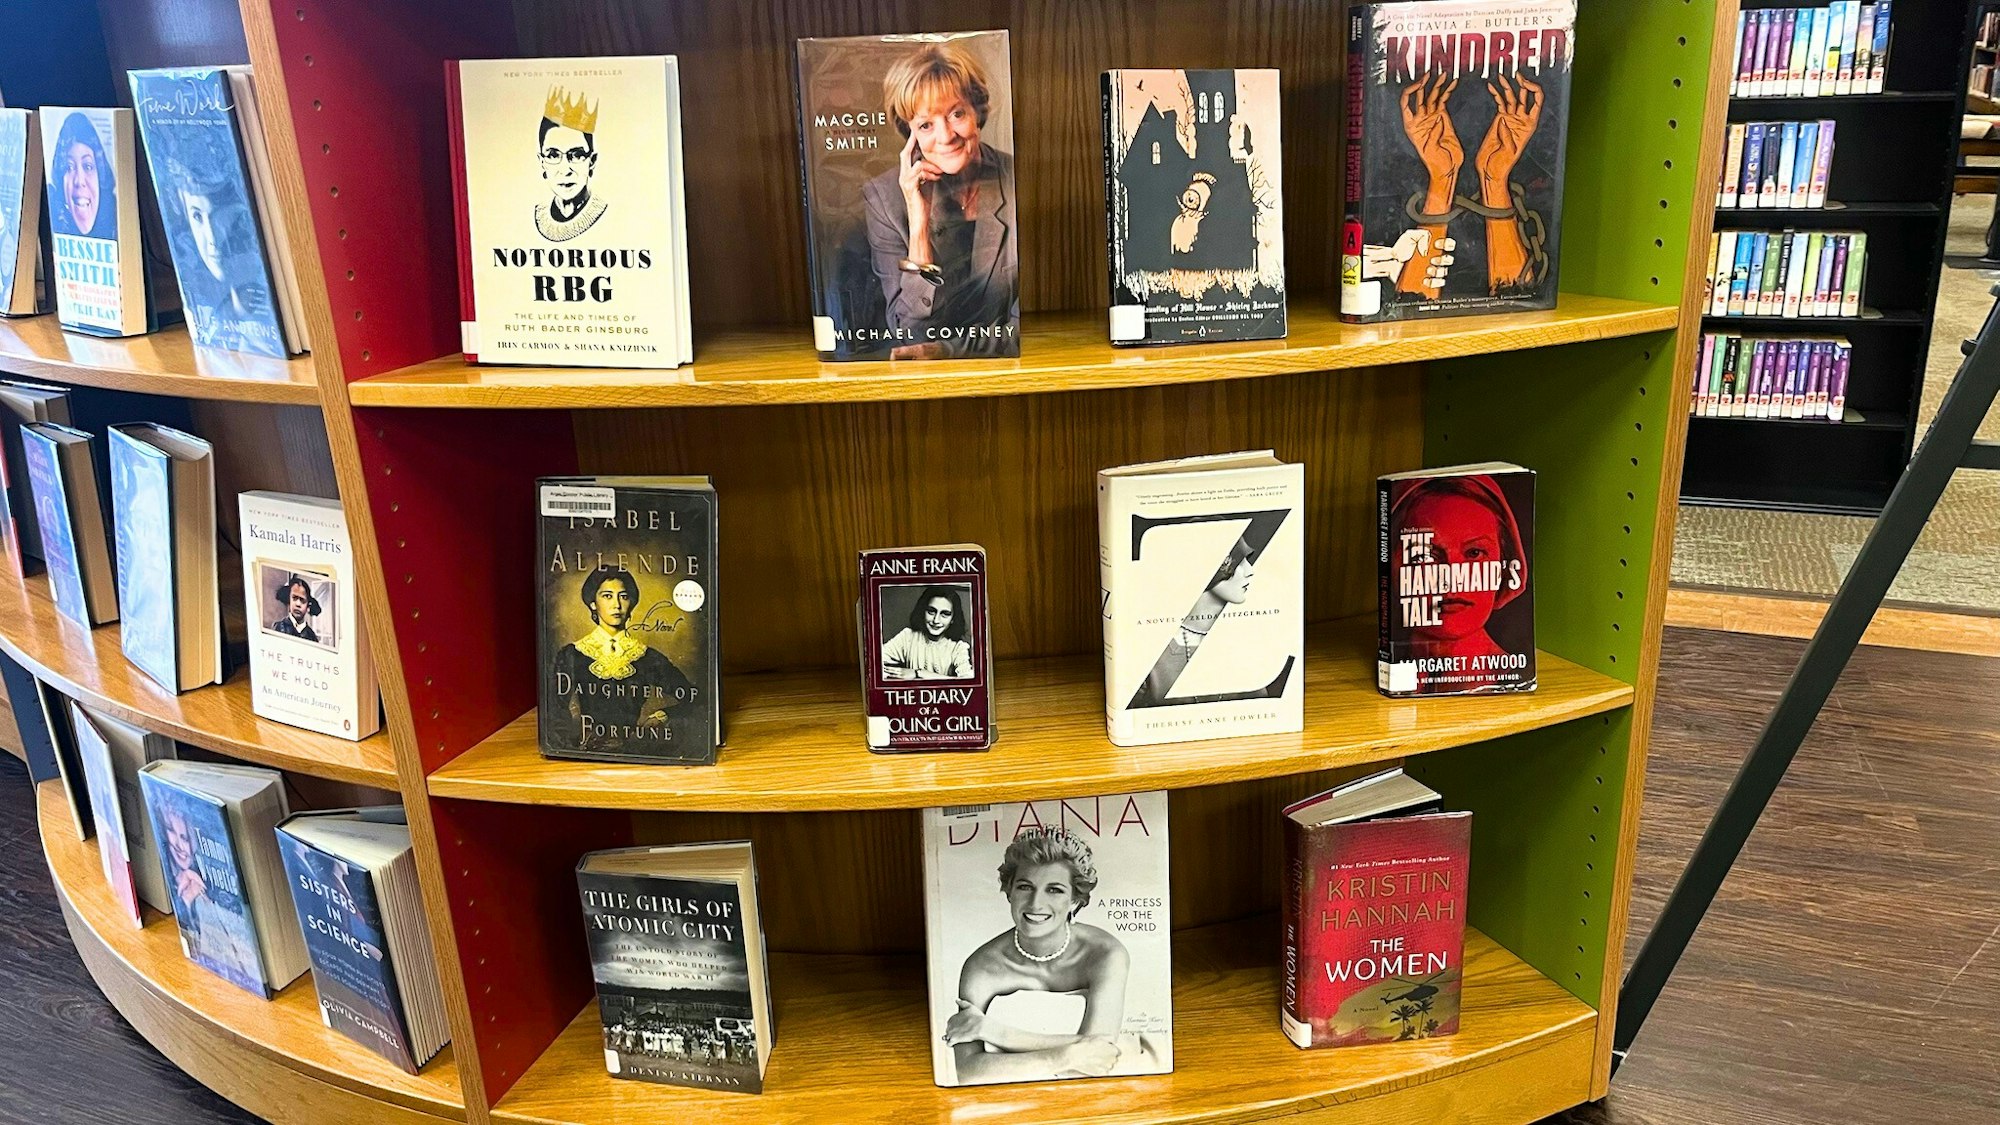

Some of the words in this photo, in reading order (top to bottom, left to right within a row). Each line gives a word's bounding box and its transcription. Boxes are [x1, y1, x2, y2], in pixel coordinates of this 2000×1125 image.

[1395, 21, 1457, 32] OCTAVIA
[1465, 20, 1477, 29] E.
[1485, 16, 1553, 28] BUTLER'S
[1386, 28, 1567, 83] KINDRED
[176, 80, 235, 115] Work
[814, 112, 887, 127] MAGGIE
[825, 136, 878, 150] SMITH
[57, 237, 114, 264] BESSIE
[1346, 231, 1356, 249] A
[493, 248, 652, 269] NOTORIOUS
[60, 261, 116, 288] SMITH
[533, 275, 613, 303] RBG
[1145, 304, 1169, 315] aunting
[1171, 304, 1179, 312] of
[1180, 303, 1194, 314] Hill
[1195, 303, 1217, 314] House
[1225, 302, 1250, 312] Shirley
[1252, 301, 1279, 310] Jackson
[223, 320, 278, 341] ANDREWS
[505, 324, 535, 332] RUTH
[541, 325, 581, 333] BADER
[586, 326, 649, 334] GINSBURG
[834, 328, 914, 341] MICHAEL
[926, 325, 1015, 340] COVENEY
[498, 341, 518, 349] IRIN
[521, 342, 560, 350] CARMON
[609, 345, 658, 353] KNIZHNIK
[1380, 490, 1388, 530] MARGARET
[301, 518, 341, 529] BESTSELLER
[250, 523, 297, 545] Kamala
[301, 533, 342, 553] Harris
[1381, 531, 1389, 562] ATWOOD
[1400, 532, 1434, 565] THE
[551, 544, 699, 575] ALLENDE
[870, 558, 918, 575] ANNE
[923, 556, 979, 573] FRANK
[1400, 559, 1521, 597] HANDMAID'S
[1126, 508, 1296, 710] Z
[1147, 617, 1175, 625] NOVEL
[1189, 613, 1217, 621] ZELDA
[1222, 608, 1280, 618] FITZGERALD
[1400, 595, 1443, 628] TALE
[647, 617, 684, 633] Novel
[260, 648, 283, 663] THE
[289, 656, 340, 676] TRUTHS
[1472, 653, 1527, 671] ATWOOD
[272, 670, 288, 681] WE
[295, 675, 329, 691] HOLD
[556, 672, 664, 699] DAUGHTER
[675, 688, 699, 702] OF
[1434, 675, 1476, 683] INTRODUCTION
[1497, 673, 1519, 681] AUTHOR
[263, 685, 273, 694] An
[275, 689, 310, 704] American
[311, 697, 341, 713] Journey
[884, 690, 917, 706] THE
[920, 688, 973, 706] DIARY
[919, 706, 930, 715] OF
[932, 706, 940, 715] A
[1146, 720, 1193, 729] THERESE
[1199, 717, 1227, 725] ANNE
[1233, 713, 1277, 722] FOWLER
[579, 715, 673, 744] FORTUNE
[889, 717, 941, 733] OUNG
[945, 716, 984, 732] GIRL
[195, 827, 231, 870] Tammy
[1391, 857, 1426, 865] Bestselling
[1428, 855, 1450, 863] Author
[195, 853, 238, 896] Wynette
[299, 874, 357, 915] SISTERS
[1327, 870, 1451, 901] KRISTIN
[326, 903, 342, 923] IN
[585, 890, 630, 910] THE
[636, 895, 699, 916] GIRLS
[706, 900, 734, 918] OF
[1098, 898, 1106, 908] A
[1110, 898, 1162, 907] PRINCESS
[1107, 910, 1128, 920] FOR
[1132, 910, 1153, 920] THE
[1320, 899, 1456, 932] HANNAH
[307, 914, 370, 960] SCIENCE
[592, 914, 675, 937] ATOMIC
[682, 922, 735, 942] CITY
[1116, 922, 1157, 932] WORLD
[1287, 924, 1295, 942] THE
[615, 943, 631, 951] THE
[635, 945, 673, 955] UNTOLD
[675, 950, 703, 958] STORY
[1370, 937, 1404, 954] THE
[631, 957, 663, 965] WOMEN
[667, 960, 688, 968] WHO
[691, 962, 728, 971] HELPED
[1325, 951, 1447, 983] WOMEN
[648, 970, 680, 978] WORLD
[683, 972, 702, 980] WAR
[1286, 944, 1296, 1012] WOMEN
[323, 999, 353, 1021] OLIVIA
[355, 1015, 400, 1049] CAMPBELL
[630, 1066, 676, 1079] DENISE
[682, 1072, 740, 1086] KIERNAN
